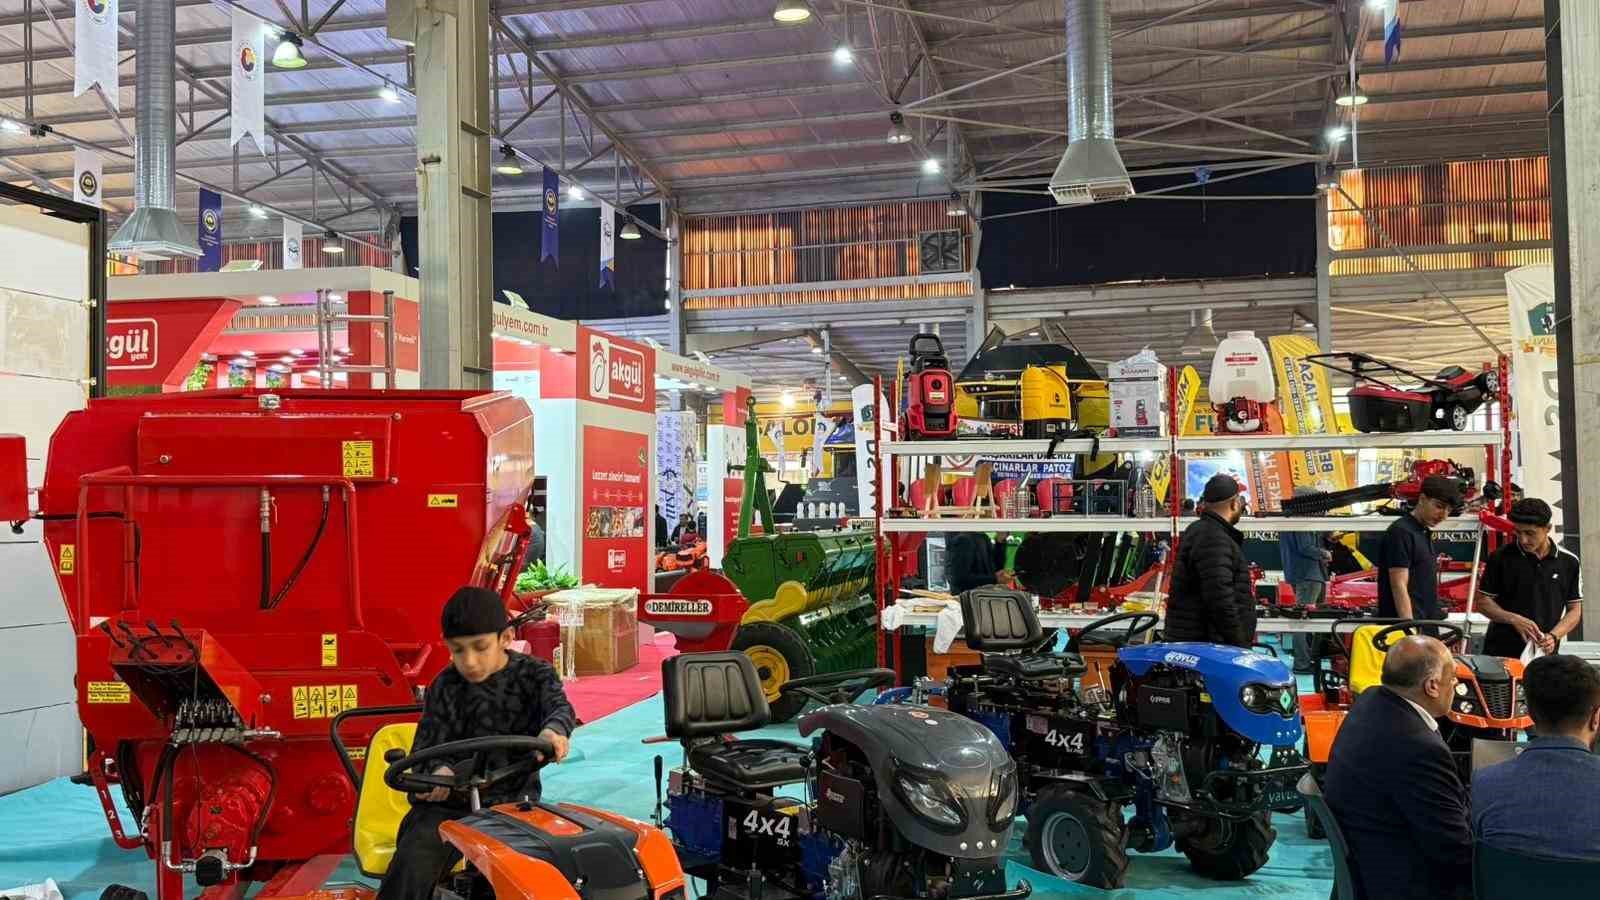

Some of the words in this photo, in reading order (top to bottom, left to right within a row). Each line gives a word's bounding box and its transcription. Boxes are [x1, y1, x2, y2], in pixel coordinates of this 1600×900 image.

[106, 328, 149, 359] gül
[611, 356, 641, 390] akgül
[1043, 463, 1072, 473] PATOZ
[1045, 729, 1083, 750] 4x4
[108, 810, 116, 820] 2
[743, 809, 790, 838] 4x4
